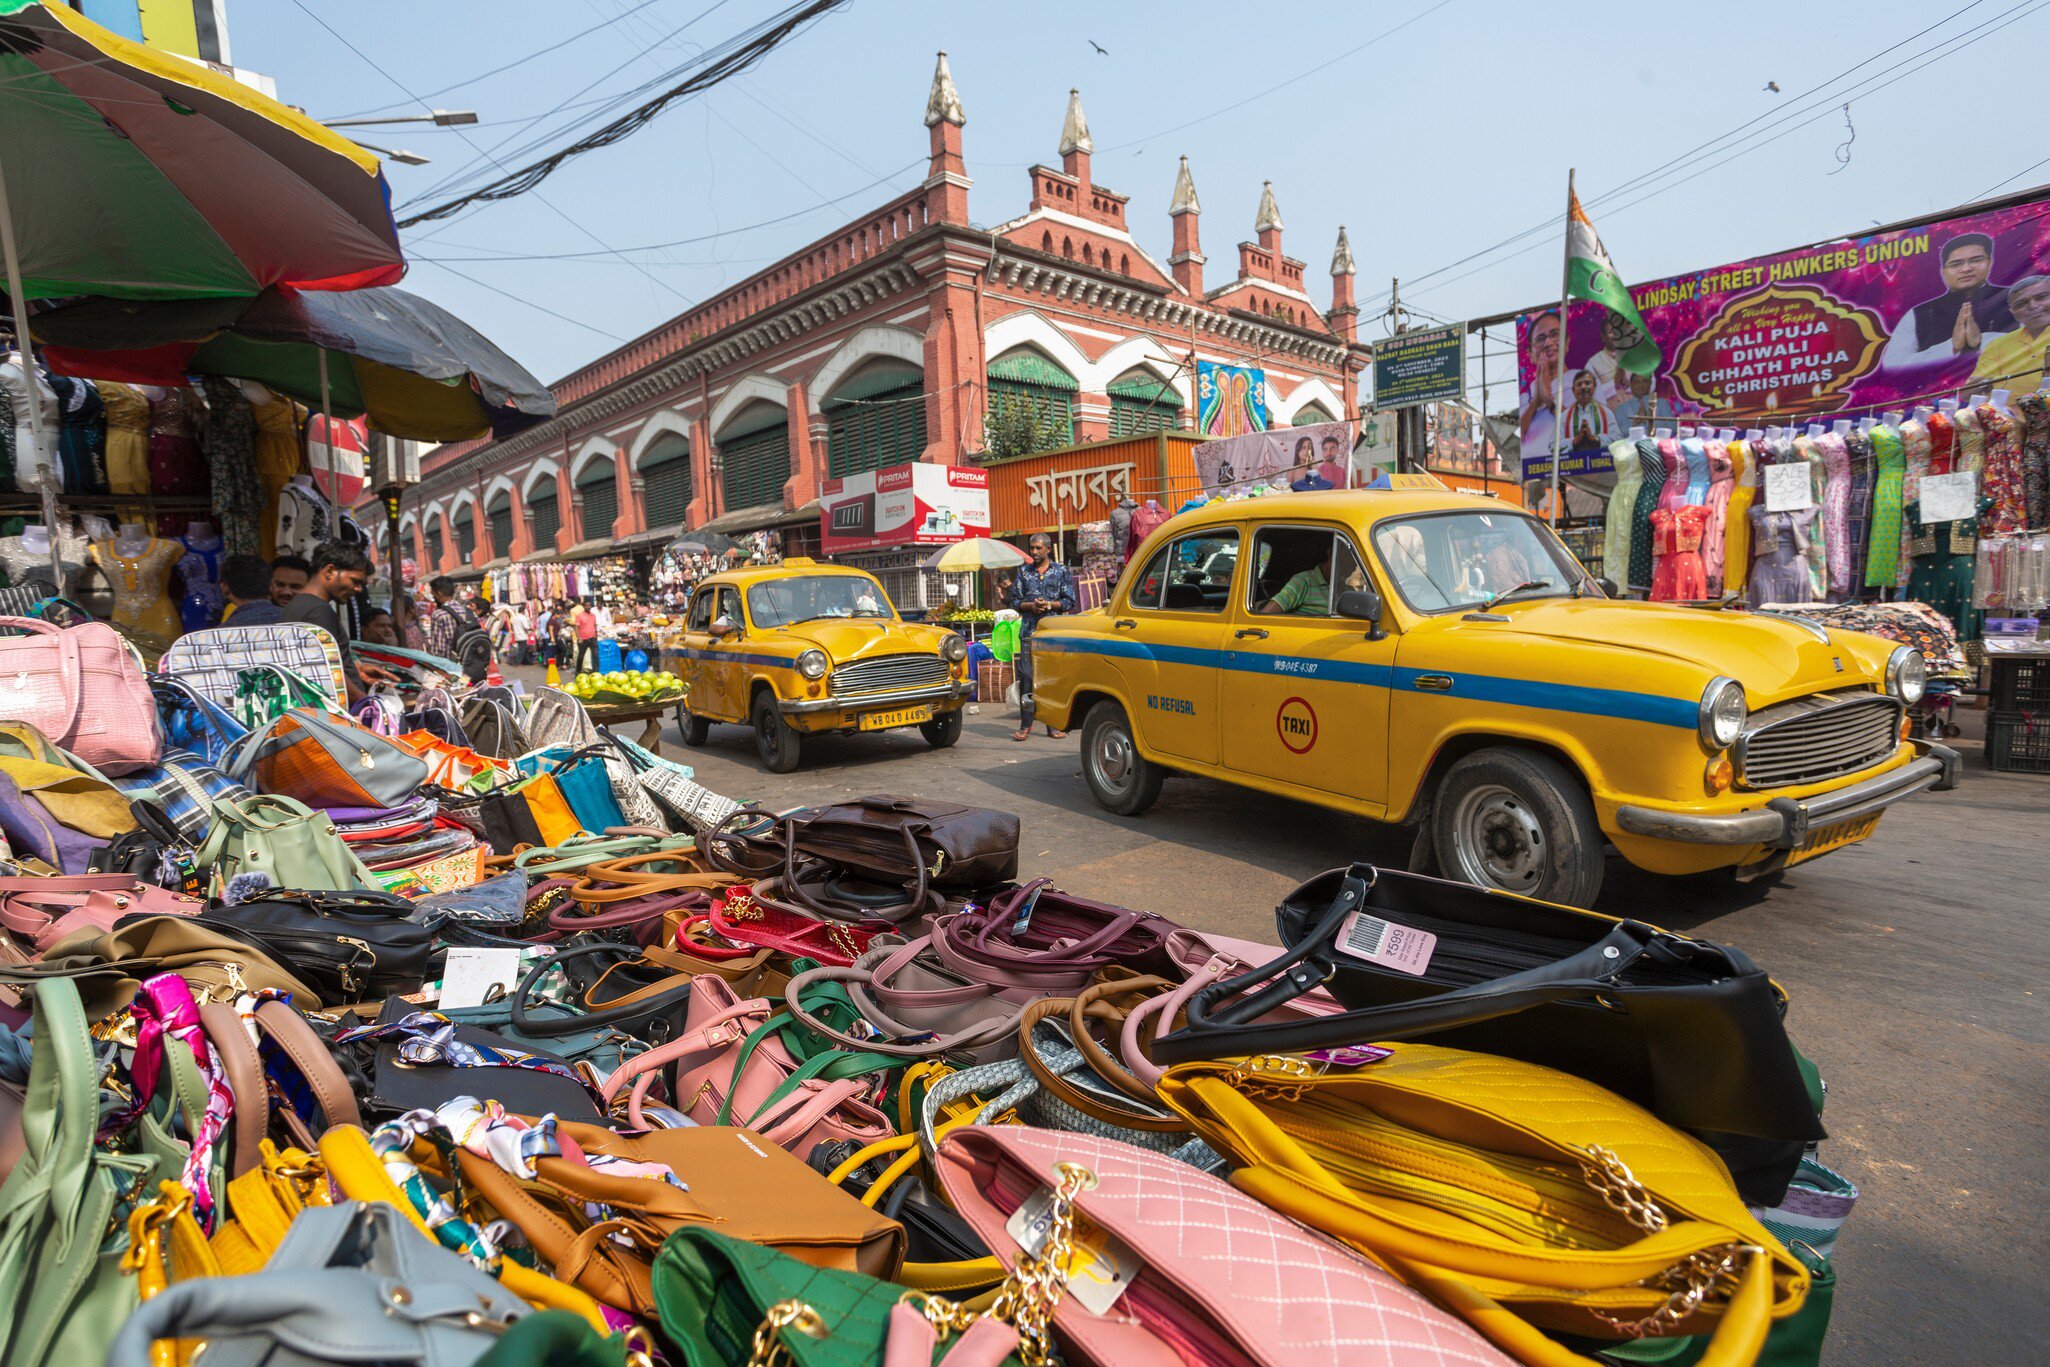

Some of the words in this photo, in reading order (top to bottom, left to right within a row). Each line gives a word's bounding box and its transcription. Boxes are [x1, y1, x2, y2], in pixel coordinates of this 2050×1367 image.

[1637, 281, 1698, 311] LINDSAY
[1700, 266, 1764, 296] STREET
[1769, 248, 1859, 282] HAWKERS
[1865, 234, 1930, 264] UNION
[1740, 304, 1780, 319] Wishing
[1784, 302, 1801, 313] you
[1754, 316, 1778, 329] Very
[1781, 311, 1817, 325] Happy
[1714, 331, 1763, 351] KALI
[1771, 321, 1829, 341] PUJA
[1732, 340, 1809, 363] DIWALI
[1698, 360, 1783, 385] CHHATH
[1790, 350, 1850, 372] PUJA
[1711, 385, 1722, 397] &
[1724, 368, 1833, 395] CHRISTMAS
[1560, 459, 1585, 471] KUMAR
[1771, 465, 1806, 480] SALE
[883, 469, 910, 484] PRITAM
[956, 470, 986, 482] PRITAM
[1025, 461, 1137, 515] মান্যবর
[881, 554, 915, 568] POLICE
[1147, 694, 1158, 709] NO
[1160, 697, 1196, 716] REFUSAL
[1283, 716, 1310, 736] TAXI
[1385, 929, 1404, 956] ₹599
